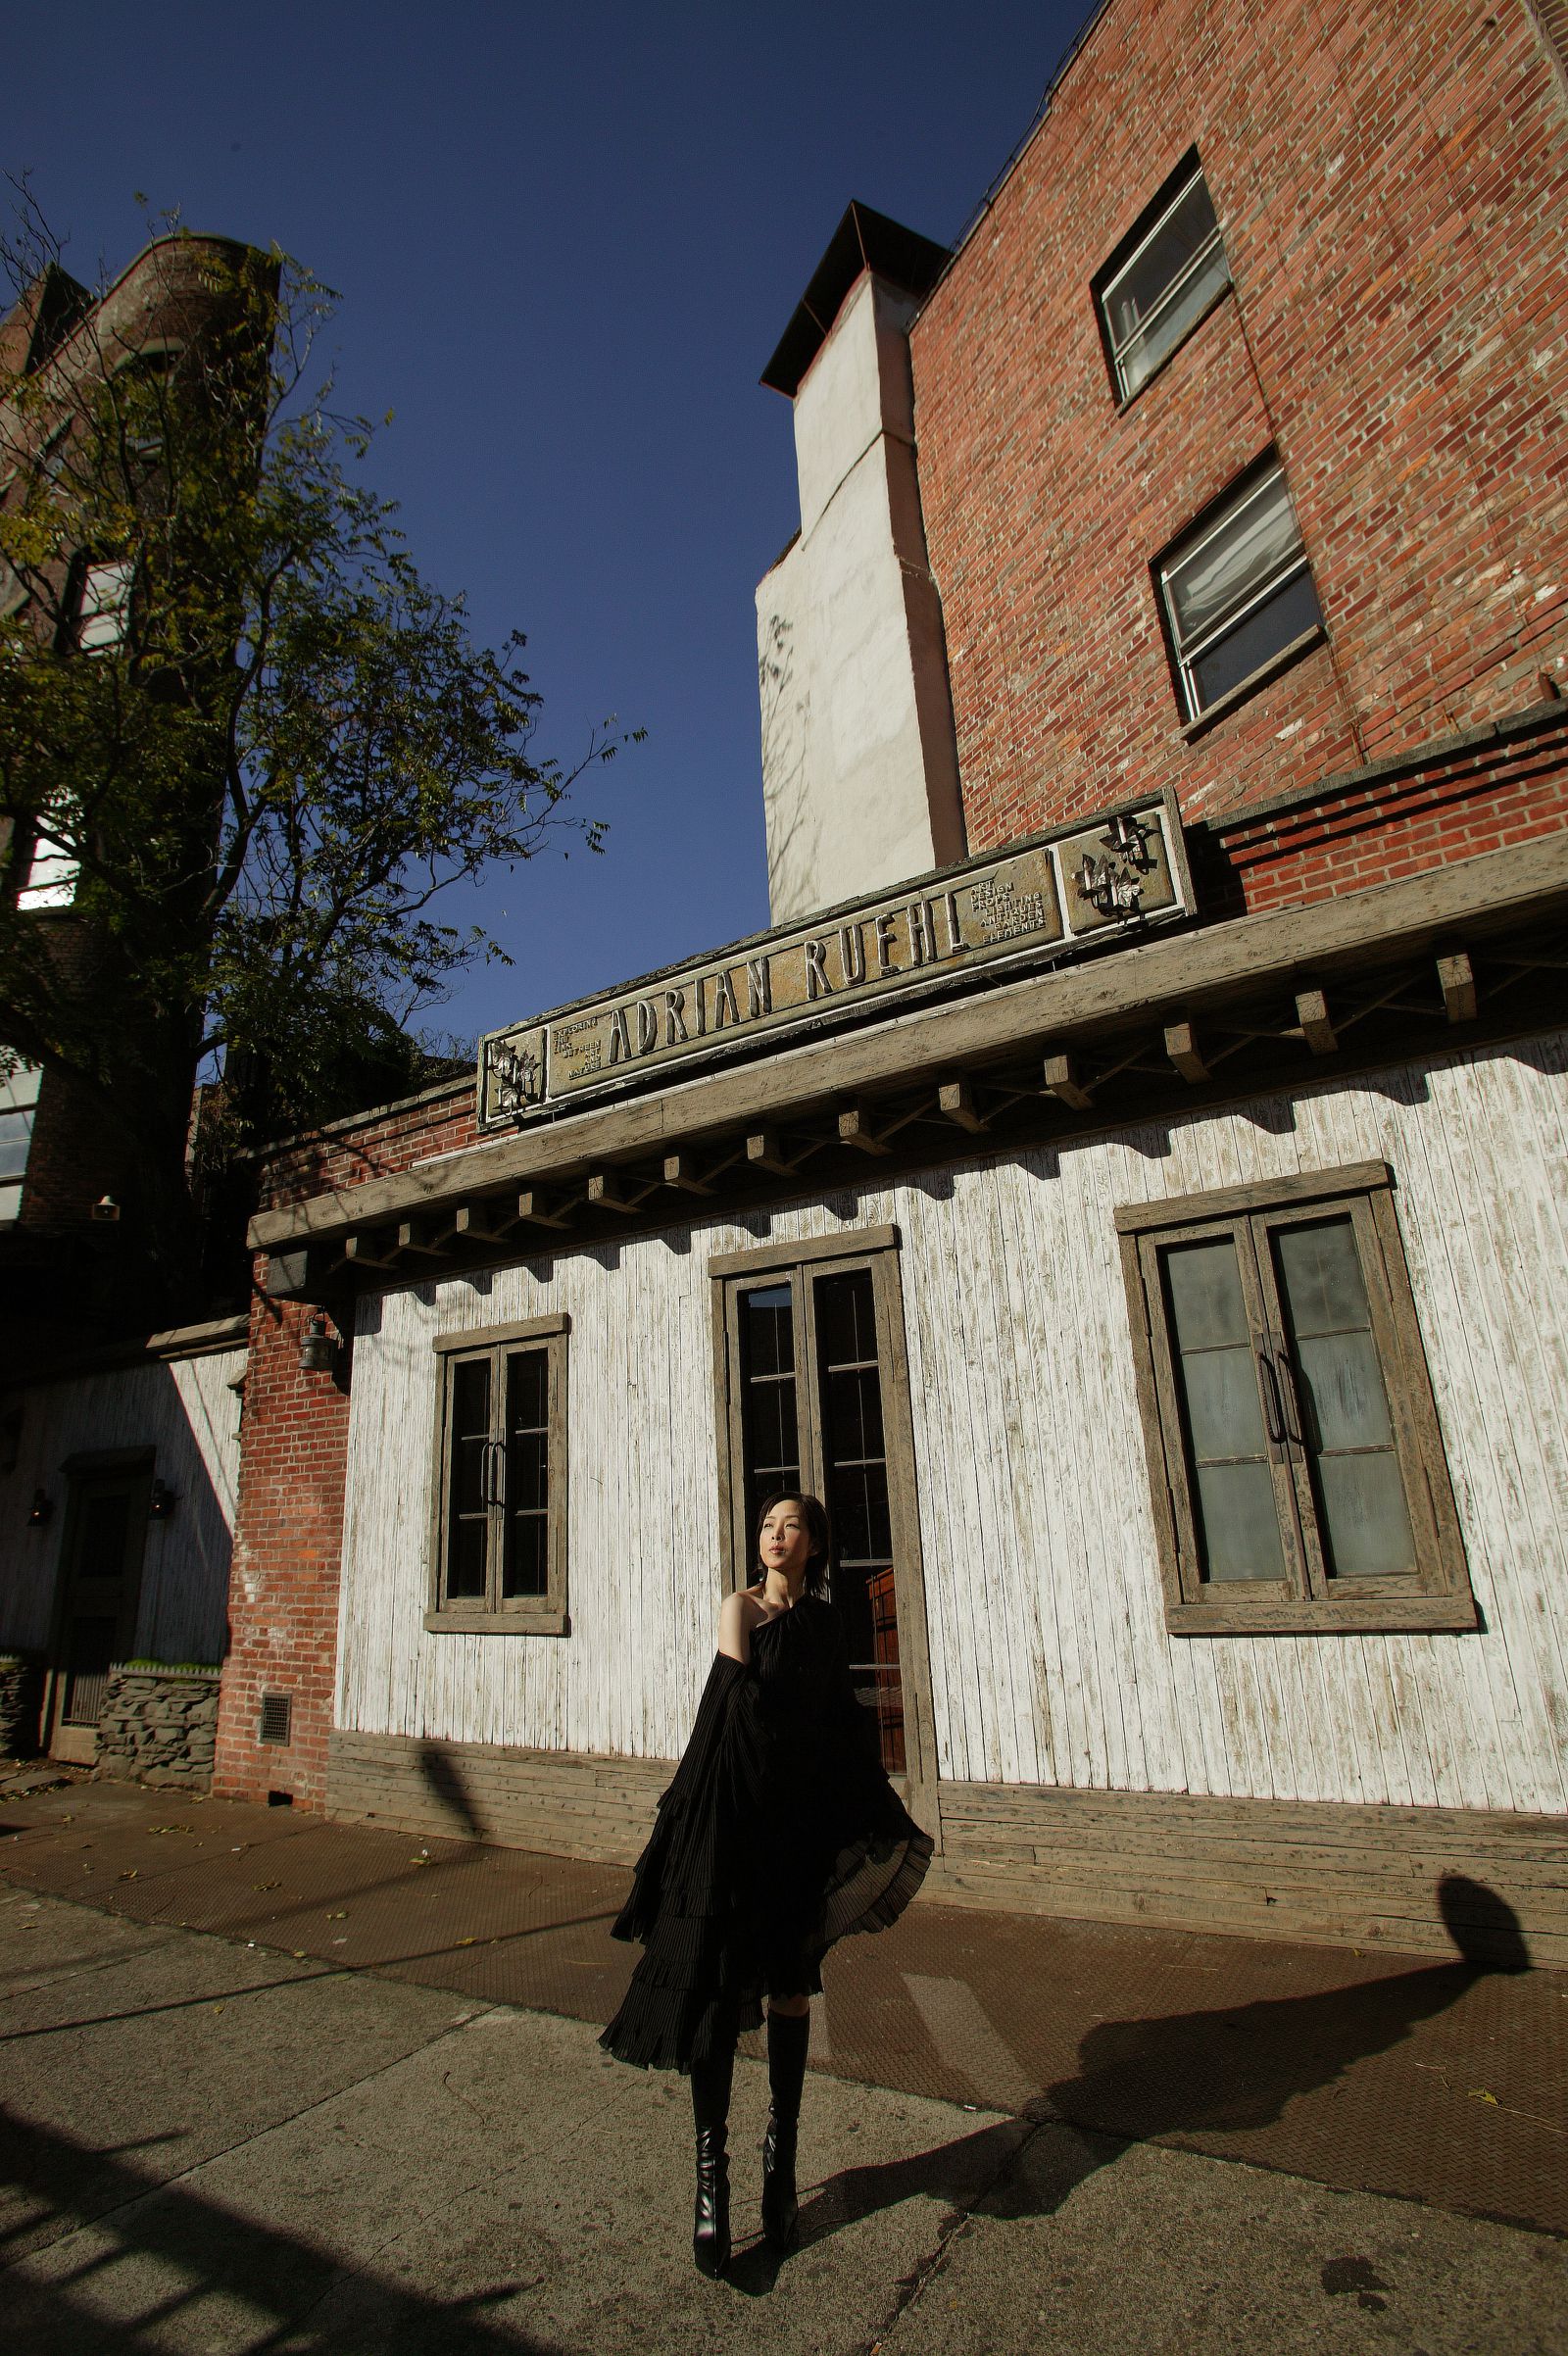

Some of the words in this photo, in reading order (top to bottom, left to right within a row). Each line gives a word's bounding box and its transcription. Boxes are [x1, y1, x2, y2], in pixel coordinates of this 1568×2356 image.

[971, 880, 994, 895] ART
[971, 882, 1014, 904] DESIGN
[972, 893, 1010, 912] PROPS
[986, 892, 1042, 916] LIGHTING
[981, 901, 1044, 927] ANTIQUES
[995, 909, 1045, 931] GARDEN
[983, 917, 1046, 944] ELEMENTS
[609, 957, 772, 1063] ADRIAN
[805, 893, 970, 1000] RUEHL
[563, 1039, 601, 1058] BETWEEN
